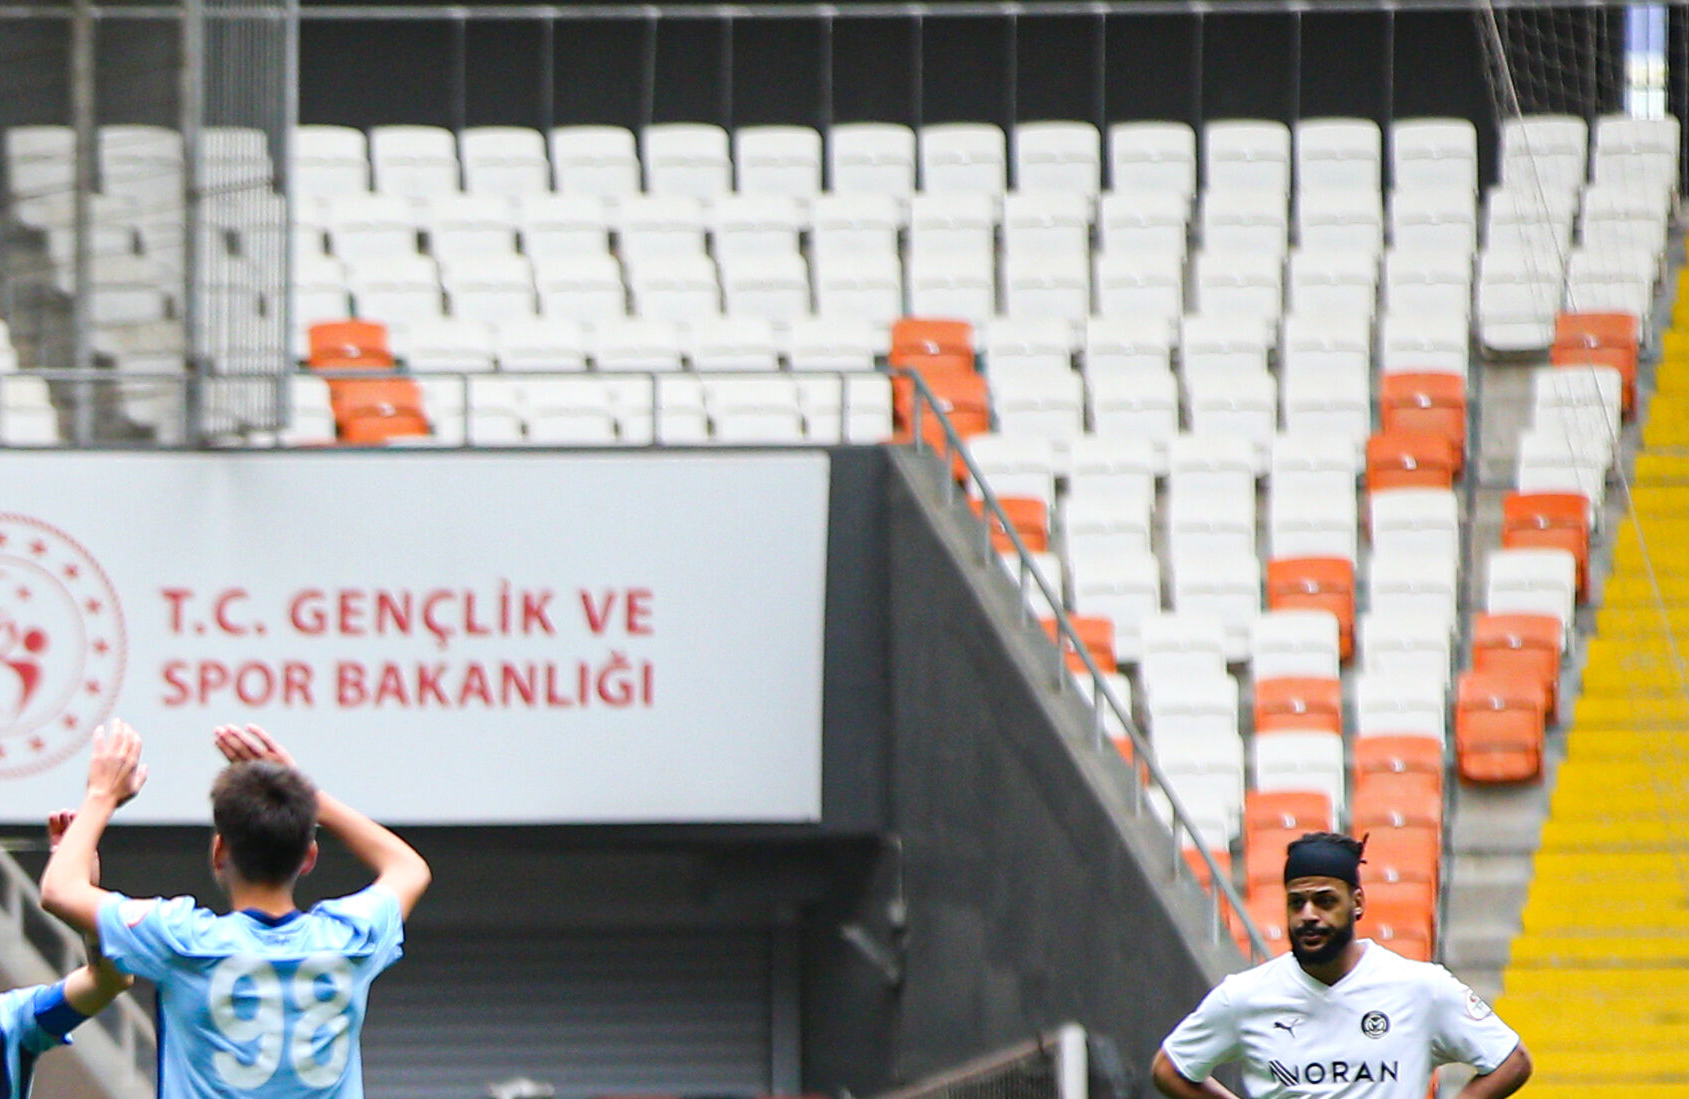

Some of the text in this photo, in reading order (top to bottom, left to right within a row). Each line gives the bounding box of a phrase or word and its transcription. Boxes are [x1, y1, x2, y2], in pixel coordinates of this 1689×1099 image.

[161, 577, 656, 649] T.C. GENÇLİK VE
[161, 648, 656, 708] SPOR BAKANLIĞI
[211, 953, 353, 1090] 98
[1267, 1059, 1399, 1087] NORAN
